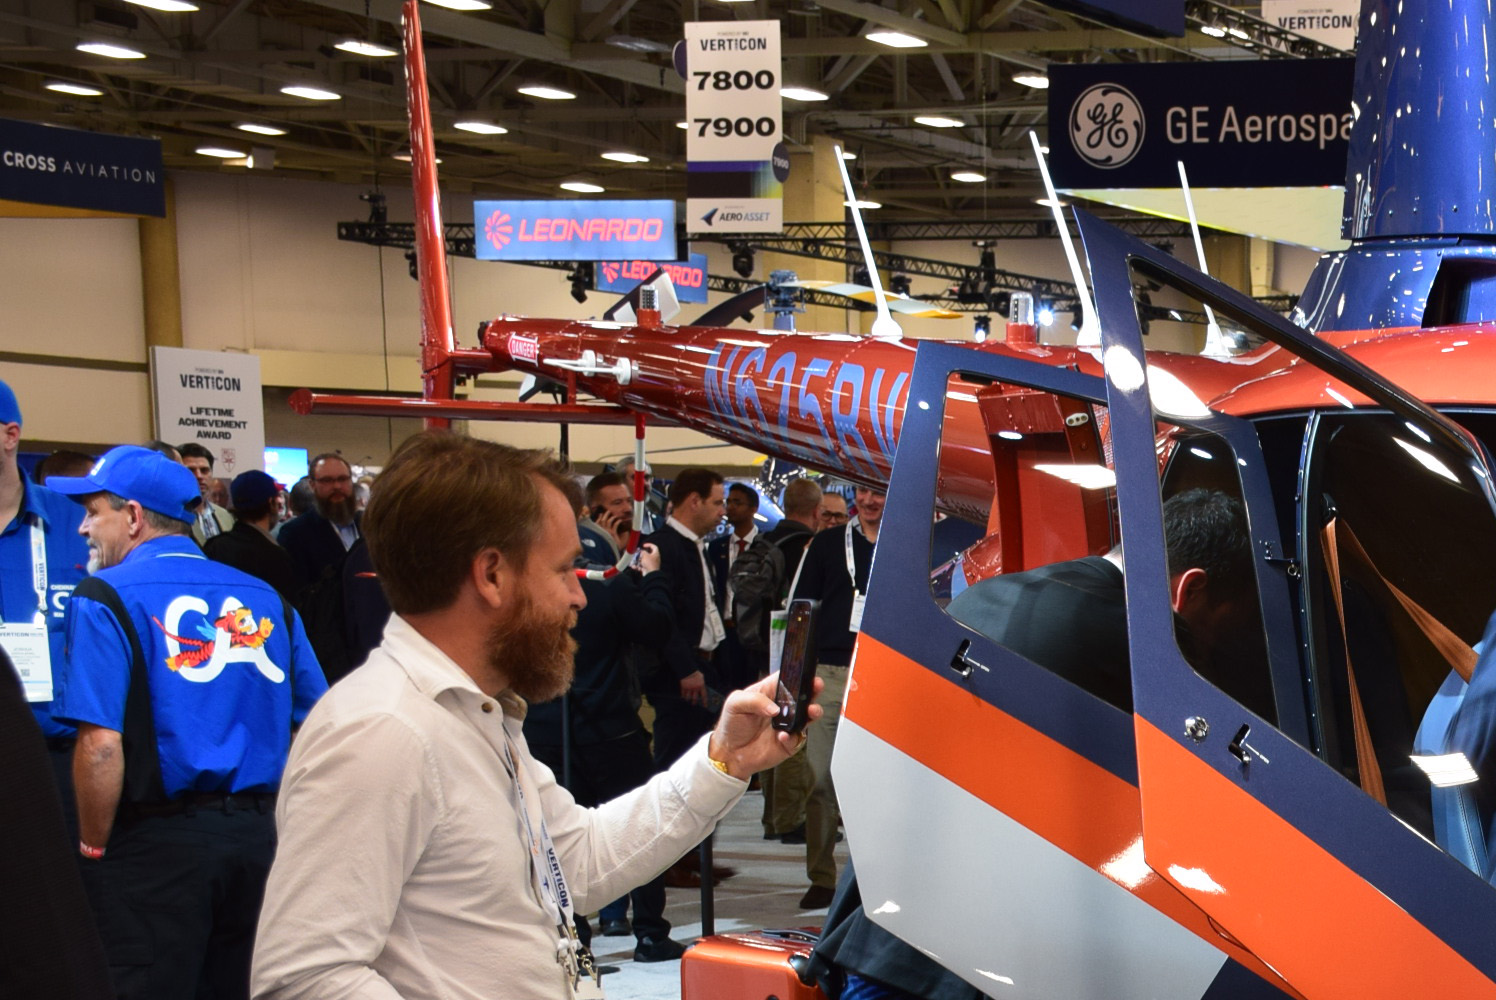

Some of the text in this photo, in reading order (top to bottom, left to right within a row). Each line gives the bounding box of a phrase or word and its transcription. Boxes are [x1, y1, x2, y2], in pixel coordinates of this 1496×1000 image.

[1278, 15, 1352, 30] VERTICON
[700, 38, 767, 51] VERTICON
[693, 70, 775, 91] 7800
[693, 117, 776, 138] 7900
[1166, 105, 1351, 150] GE Aerospa
[3, 151, 156, 184] CROSS AVIATION
[719, 212, 770, 222] AERO ASSET
[518, 218, 664, 242] LEONARDO
[511, 339, 535, 360] DANGER
[180, 373, 241, 392] VERTICON
[190, 406, 235, 417] LIFETIME
[178, 417, 248, 430] ACHIEVEMENT
[196, 430, 232, 440] AWARD
[548, 847, 570, 908] VERTICON
